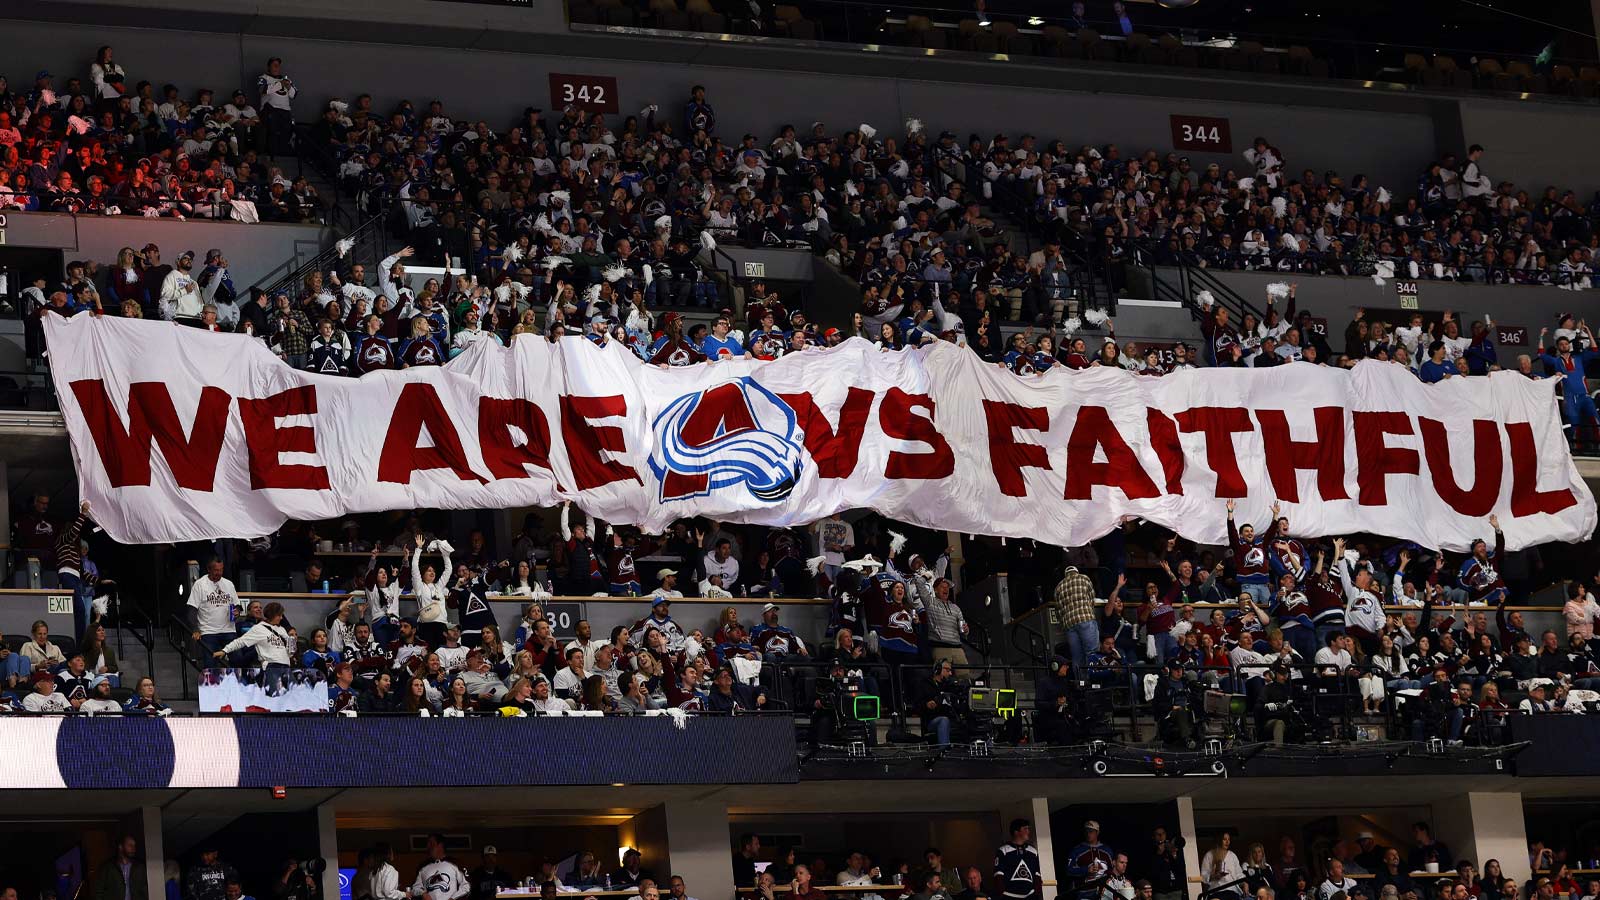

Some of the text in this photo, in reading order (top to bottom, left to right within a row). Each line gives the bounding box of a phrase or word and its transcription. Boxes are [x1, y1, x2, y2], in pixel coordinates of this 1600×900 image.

[562, 83, 606, 104] 342
[1181, 124, 1221, 144] 344
[746, 263, 764, 277] EXIT
[1396, 282, 1418, 294] 344
[1400, 296, 1417, 308] EXIT
[1312, 324, 1326, 336] 42
[1500, 332, 1520, 344] 346
[1158, 349, 1175, 364] 43
[69, 378, 331, 492] WE
[377, 382, 645, 493] ARE
[982, 398, 1577, 518] FAITHFUL
[49, 597, 71, 613] EXIT
[546, 611, 571, 630] 30
